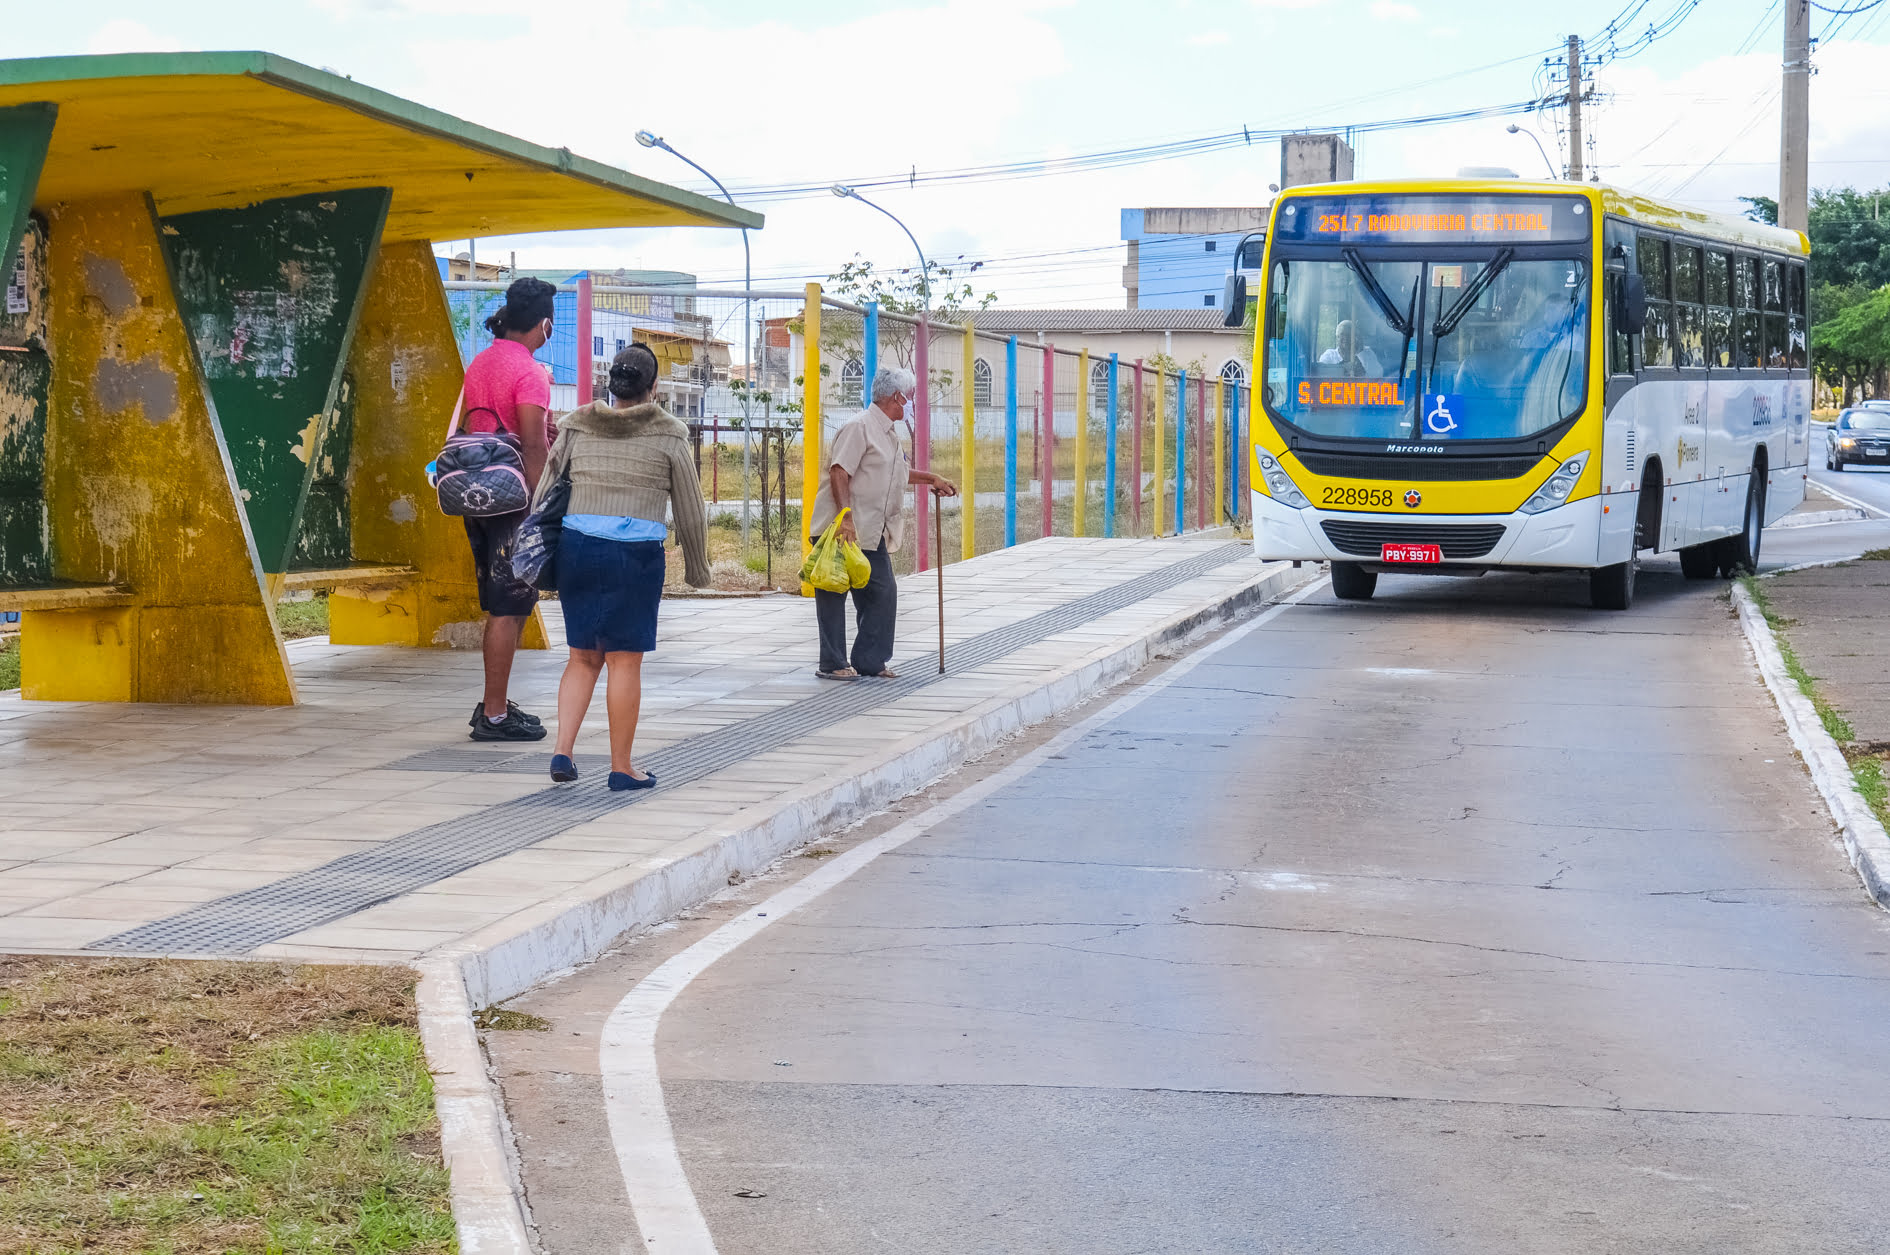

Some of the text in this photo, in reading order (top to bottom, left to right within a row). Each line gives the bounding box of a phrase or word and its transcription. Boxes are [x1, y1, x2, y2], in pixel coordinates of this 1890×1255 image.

[1318, 213, 1548, 232] 251.7 RODOVIARIA CENTRAL
[1319, 382, 1405, 406] CENTRAL
[1386, 444, 1444, 453] Marcopolo
[1322, 487, 1393, 507] 228958
